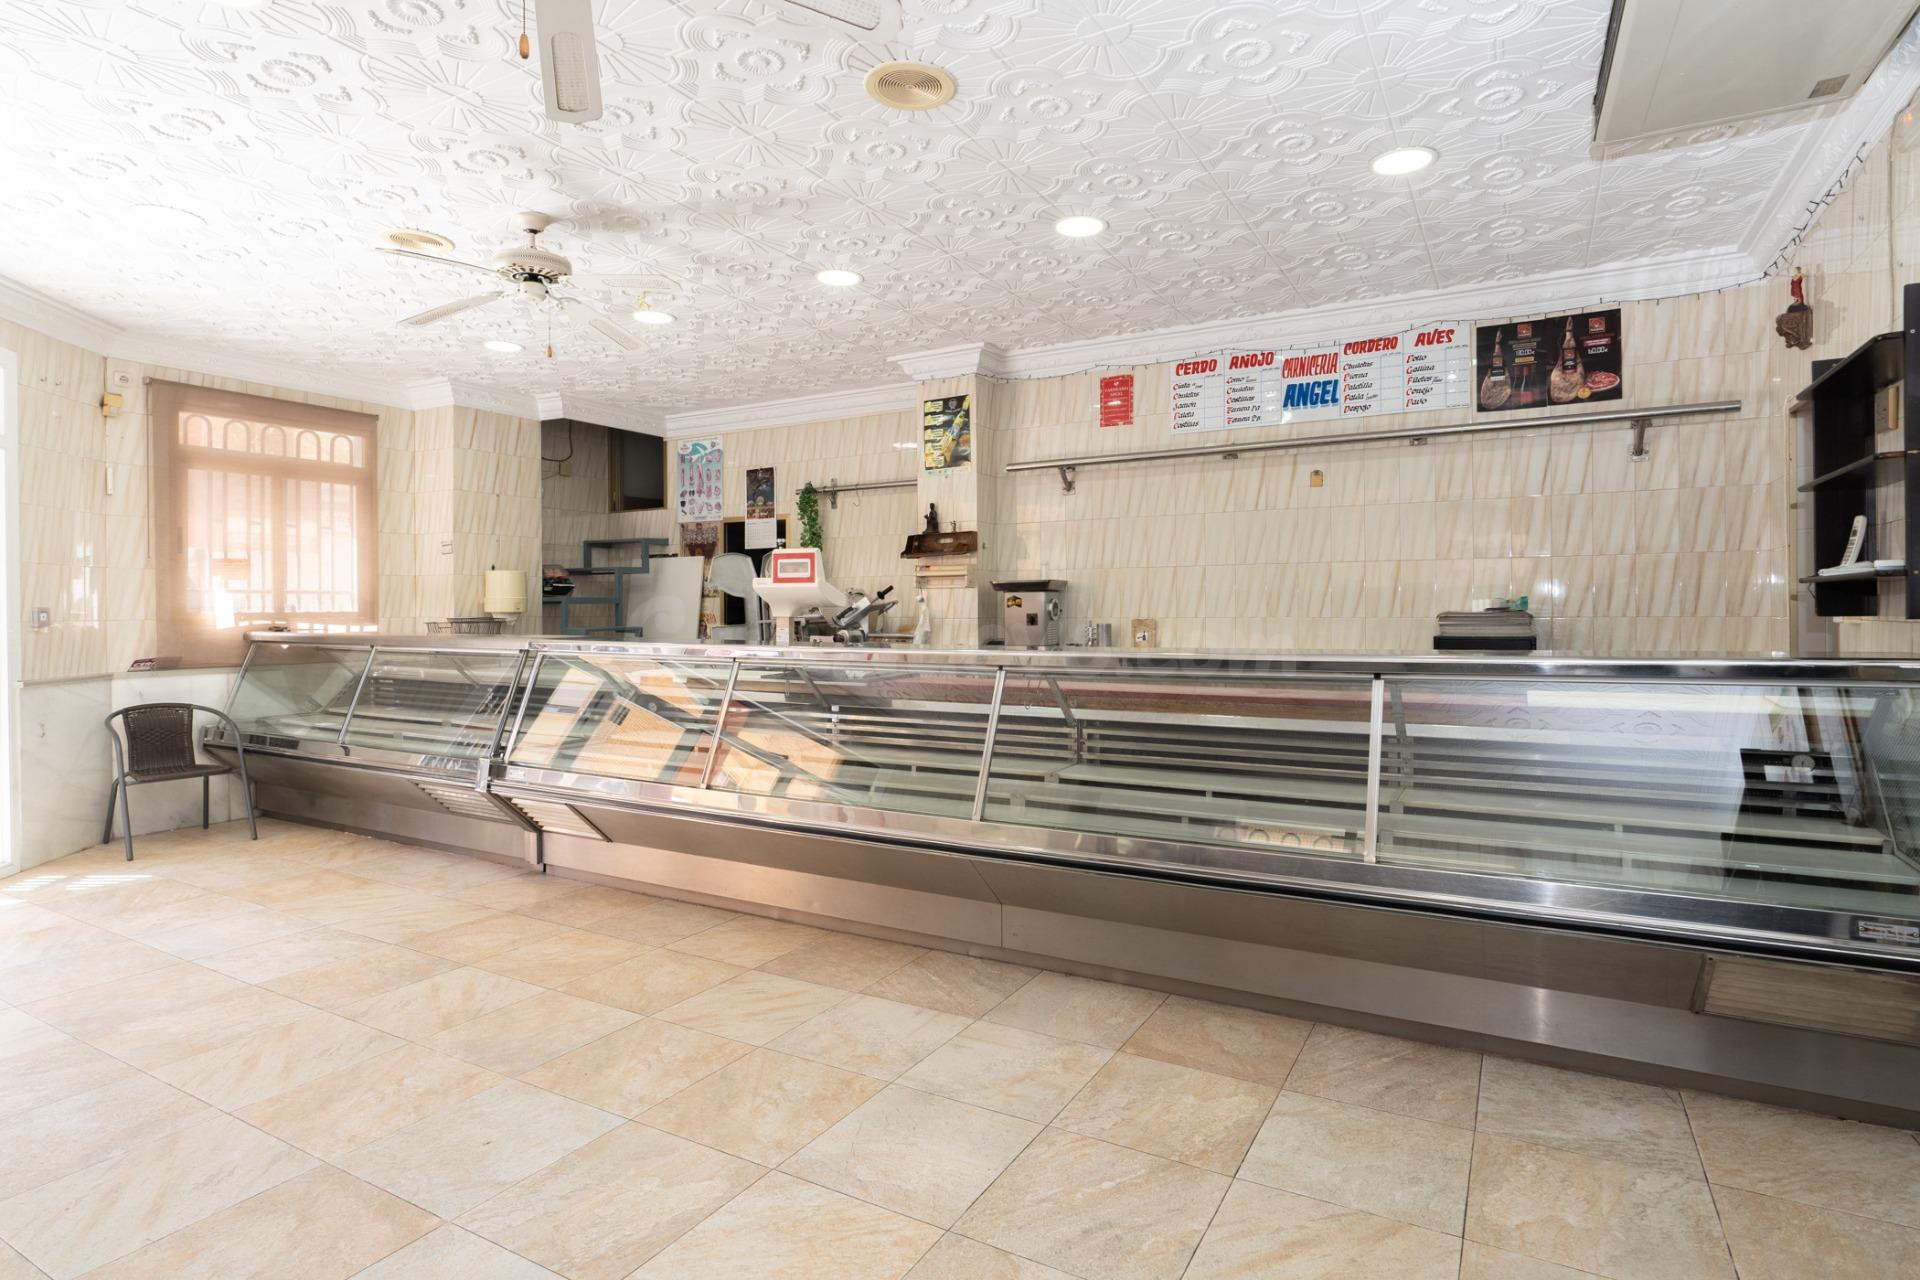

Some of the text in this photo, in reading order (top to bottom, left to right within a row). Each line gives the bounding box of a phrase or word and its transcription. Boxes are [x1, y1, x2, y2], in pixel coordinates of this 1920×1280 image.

[1414, 328, 1455, 347] AVES
[1343, 336, 1399, 356] CORDERO
[1228, 351, 1275, 370] AÑOJO
[1406, 354, 1428, 364] Pollo
[1175, 358, 1218, 377] CERDO
[1281, 352, 1339, 379] CARNICERIA
[1342, 361, 1374, 371] Chuletas
[1406, 364, 1435, 375] Gallina
[1343, 372, 1369, 382] Pierna
[1407, 376, 1433, 385] Filetes
[1343, 381, 1374, 392] Paletilla
[1406, 386, 1433, 396] Conejo
[1173, 391, 1200, 400] Chuletas
[1282, 379, 1339, 410] ANGEL
[1343, 393, 1365, 403] Falda
[1406, 398, 1428, 408] Pavo
